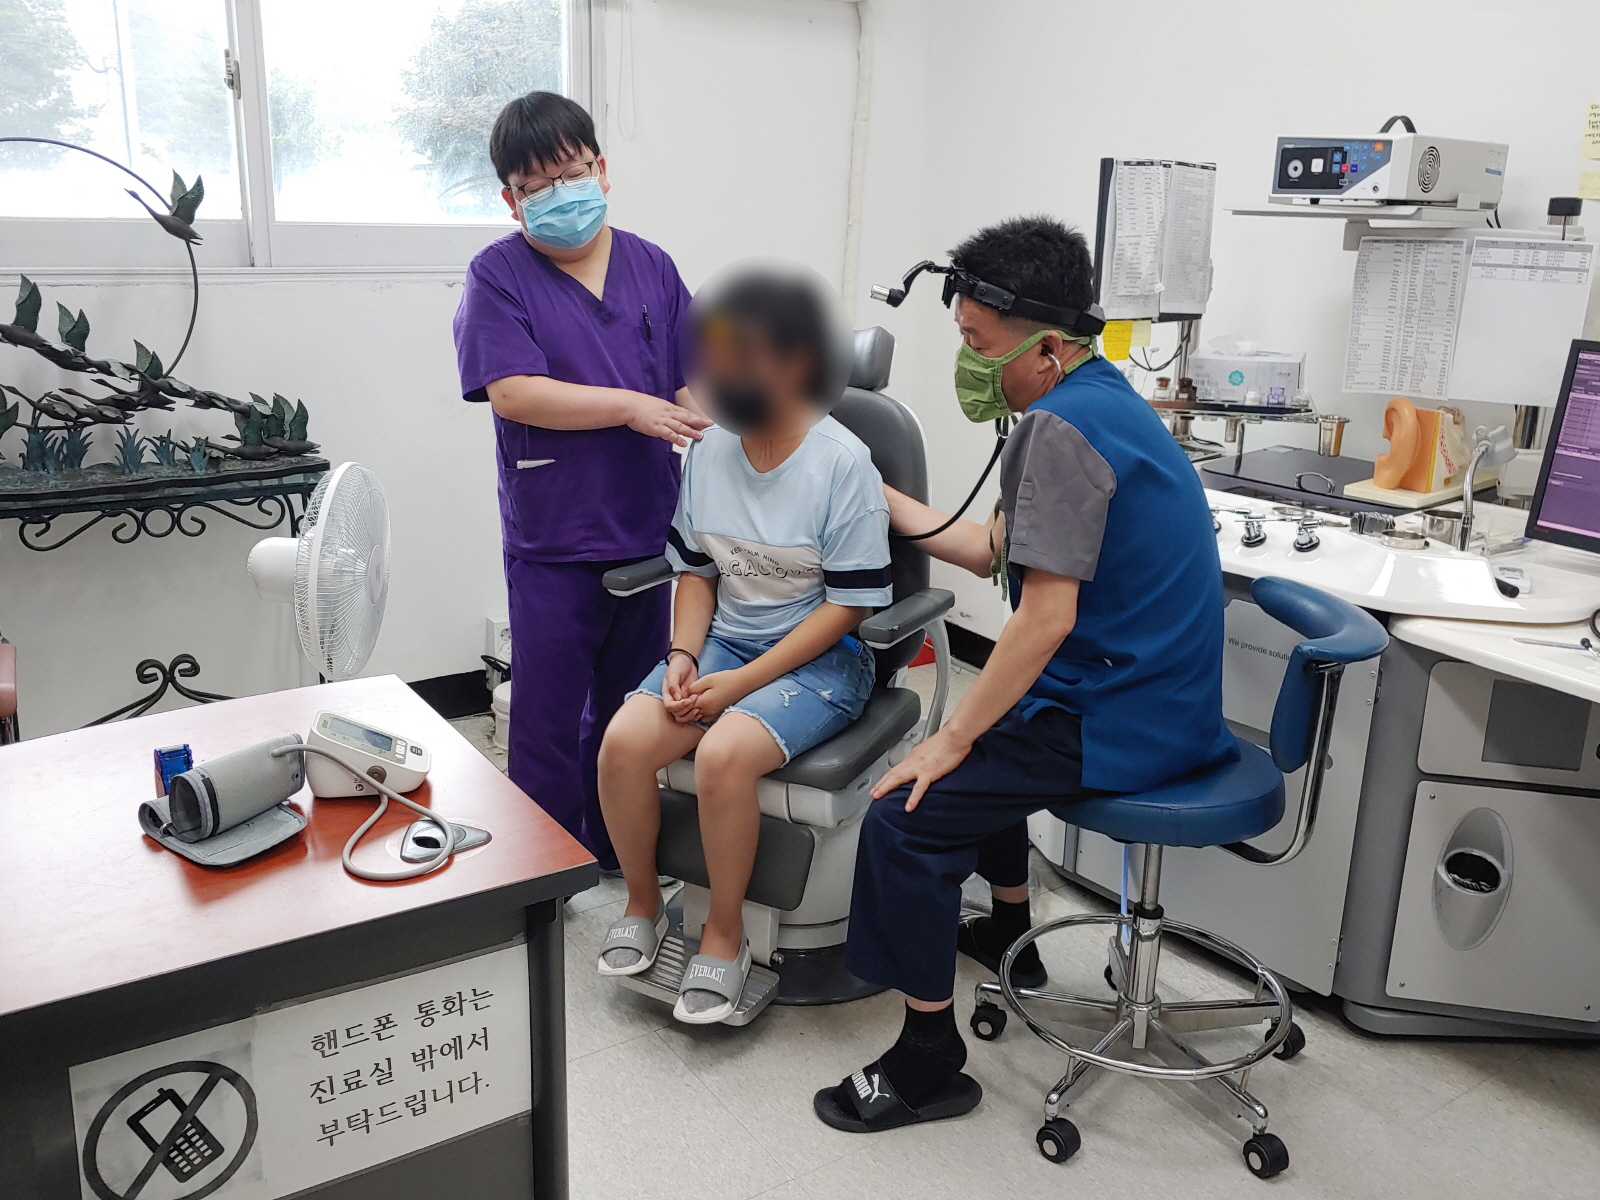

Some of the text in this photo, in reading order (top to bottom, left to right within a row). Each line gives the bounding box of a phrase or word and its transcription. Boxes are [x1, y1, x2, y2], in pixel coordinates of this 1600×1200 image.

[763, 554, 780, 566] MIND
[1228, 637, 1291, 661] We provide solutio
[605, 925, 639, 944] EVERLAST
[688, 963, 726, 984] EVERLAST
[310, 988, 495, 1059] 핸드폰 통화는
[309, 1026, 489, 1105] 진료실 밖에서
[851, 1068, 873, 1100] UMA
[316, 1071, 491, 1147] 부탁드립니다.
